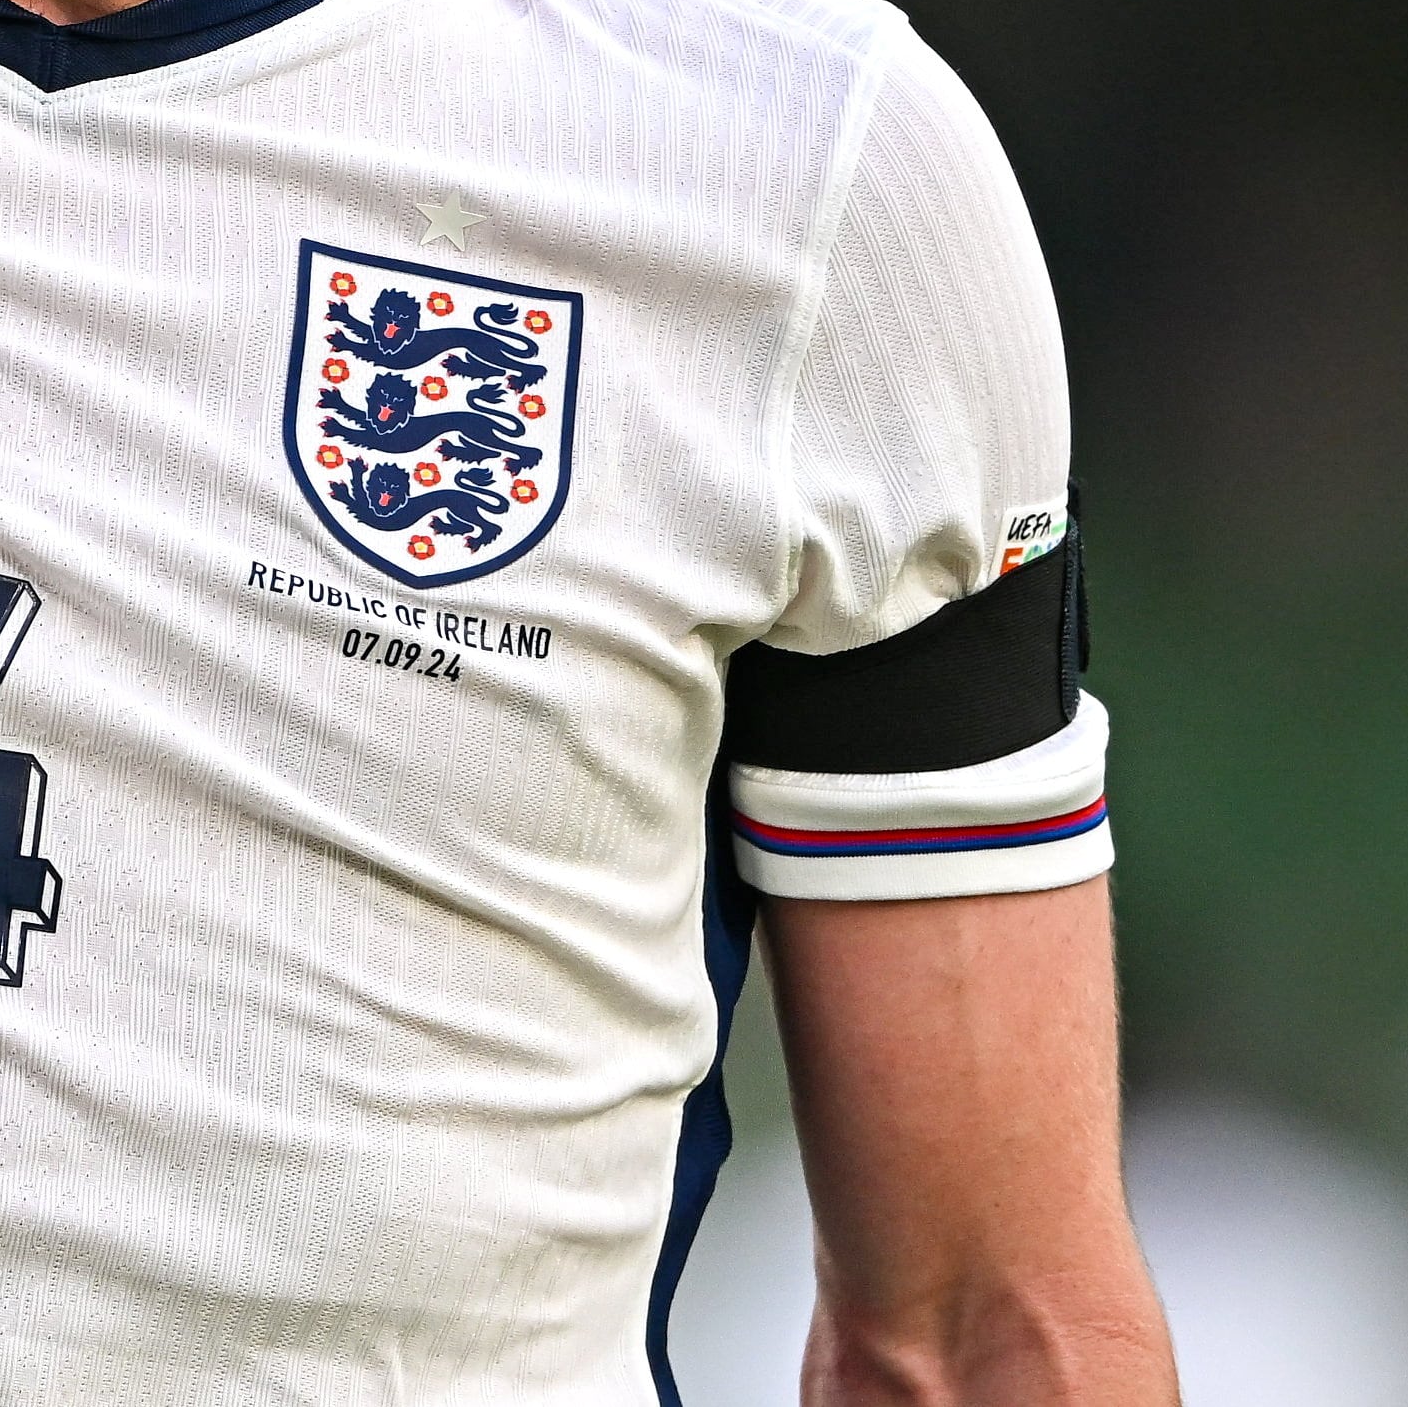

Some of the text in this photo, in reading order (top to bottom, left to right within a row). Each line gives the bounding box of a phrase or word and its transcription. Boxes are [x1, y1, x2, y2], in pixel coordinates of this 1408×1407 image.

[1007, 511, 1052, 541] UEFA
[247, 561, 552, 659] REPUBLIC OF IRELAND
[342, 628, 461, 682] 07.09.24
